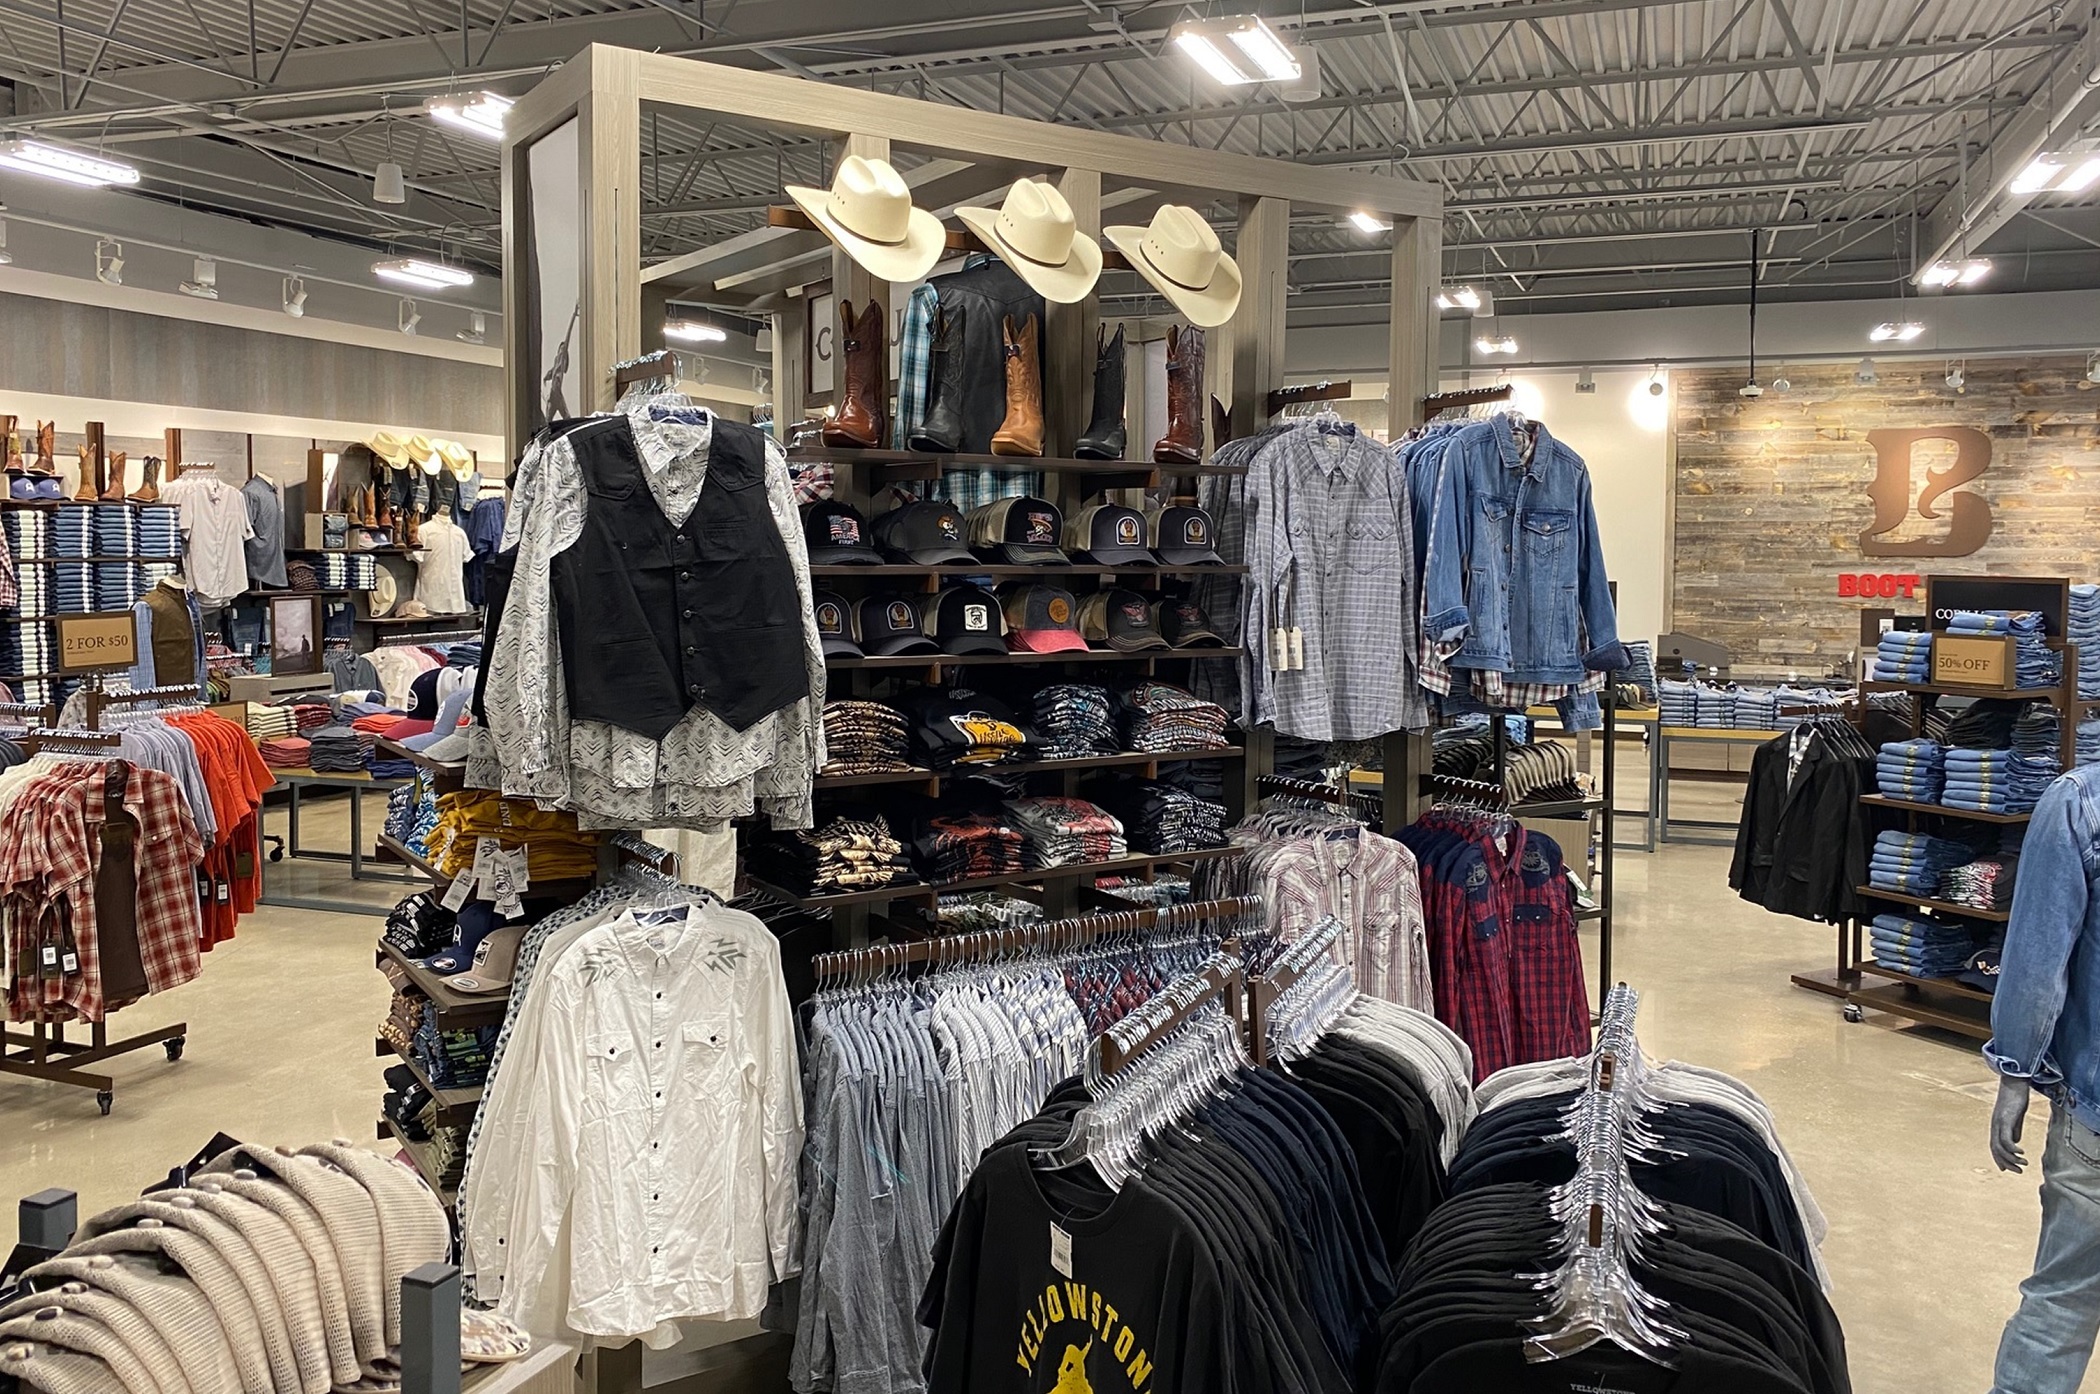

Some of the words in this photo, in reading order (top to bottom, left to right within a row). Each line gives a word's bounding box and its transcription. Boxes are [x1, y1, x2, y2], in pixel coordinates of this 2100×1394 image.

[1859, 426, 1993, 557] B
[1838, 574, 1921, 598] BOOT
[66, 638, 73, 650] 2
[77, 636, 106, 649] FOR
[108, 635, 129, 647] $50
[1938, 657, 1962, 669] 50%
[1963, 658, 1991, 670] OFF
[1016, 1281, 1153, 1394] YELLOWSTON
